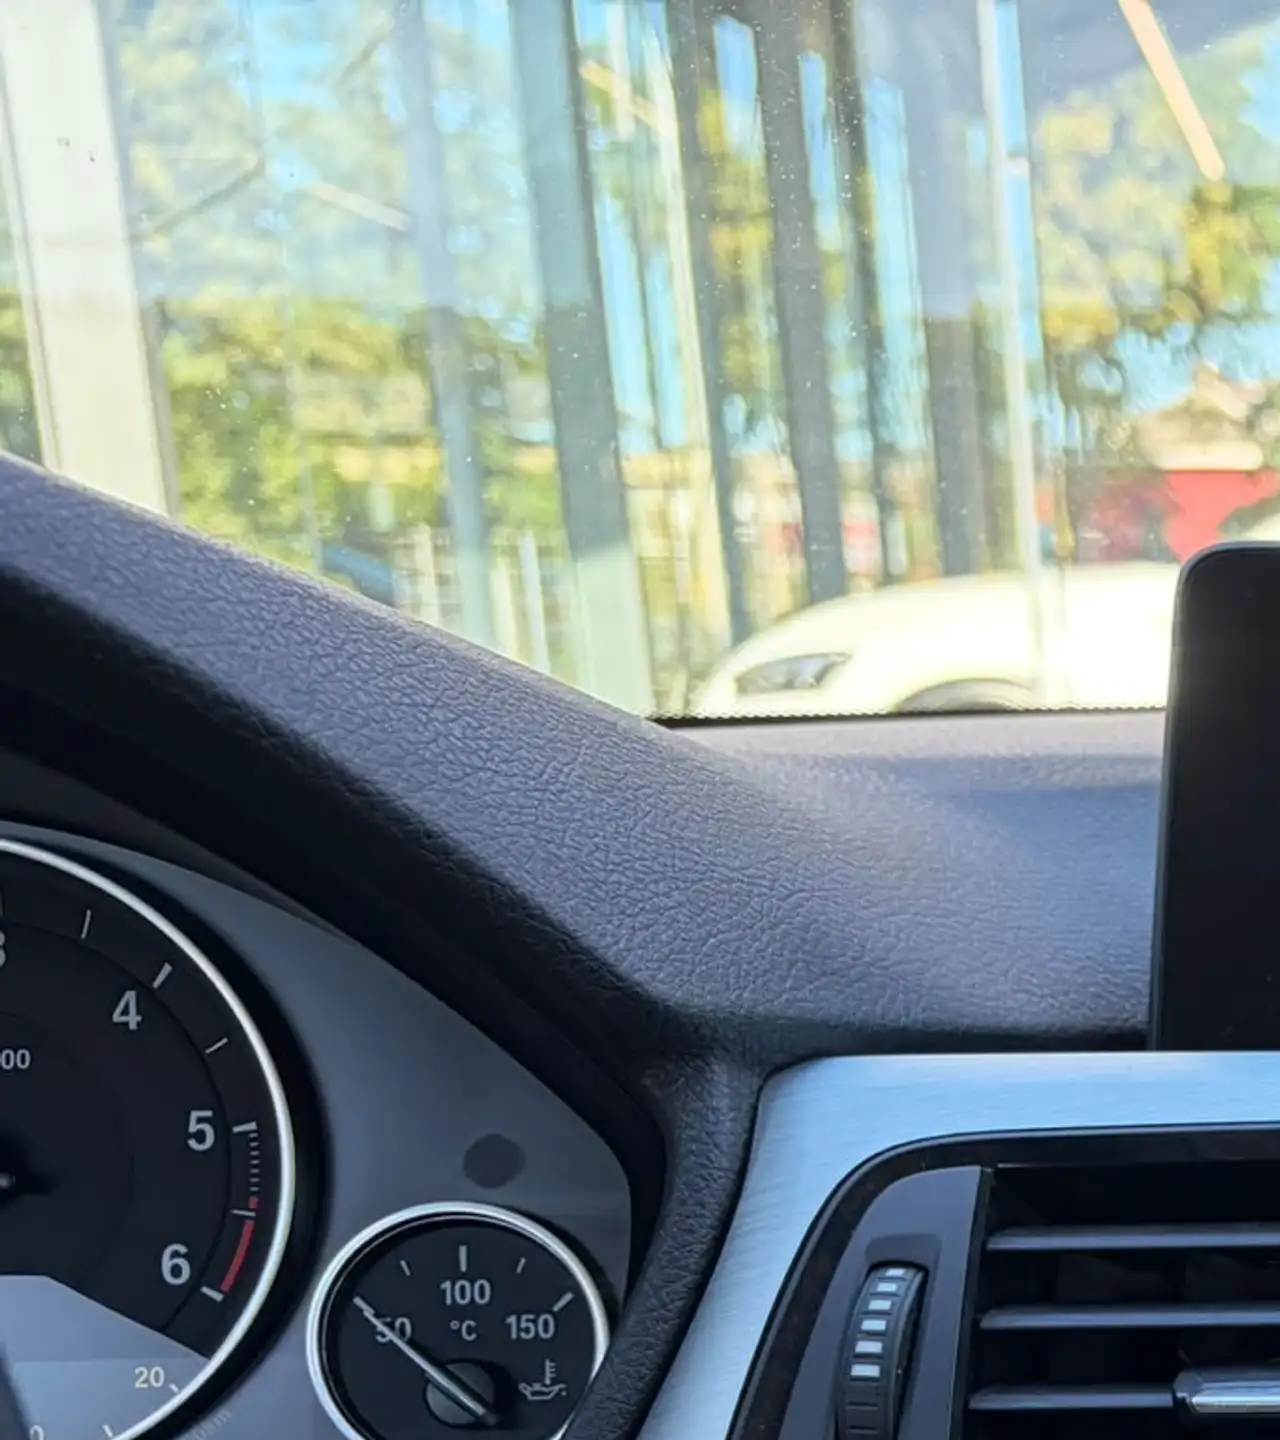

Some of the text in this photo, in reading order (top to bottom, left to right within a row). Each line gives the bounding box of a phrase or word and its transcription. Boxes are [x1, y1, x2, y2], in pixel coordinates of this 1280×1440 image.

[112, 990, 142, 1031] 4
[186, 1109, 216, 1152] 5
[160, 1243, 192, 1286] 6
[440, 1278, 491, 1306] 100
[505, 1313, 555, 1340] 150
[134, 1366, 165, 1389] 20
